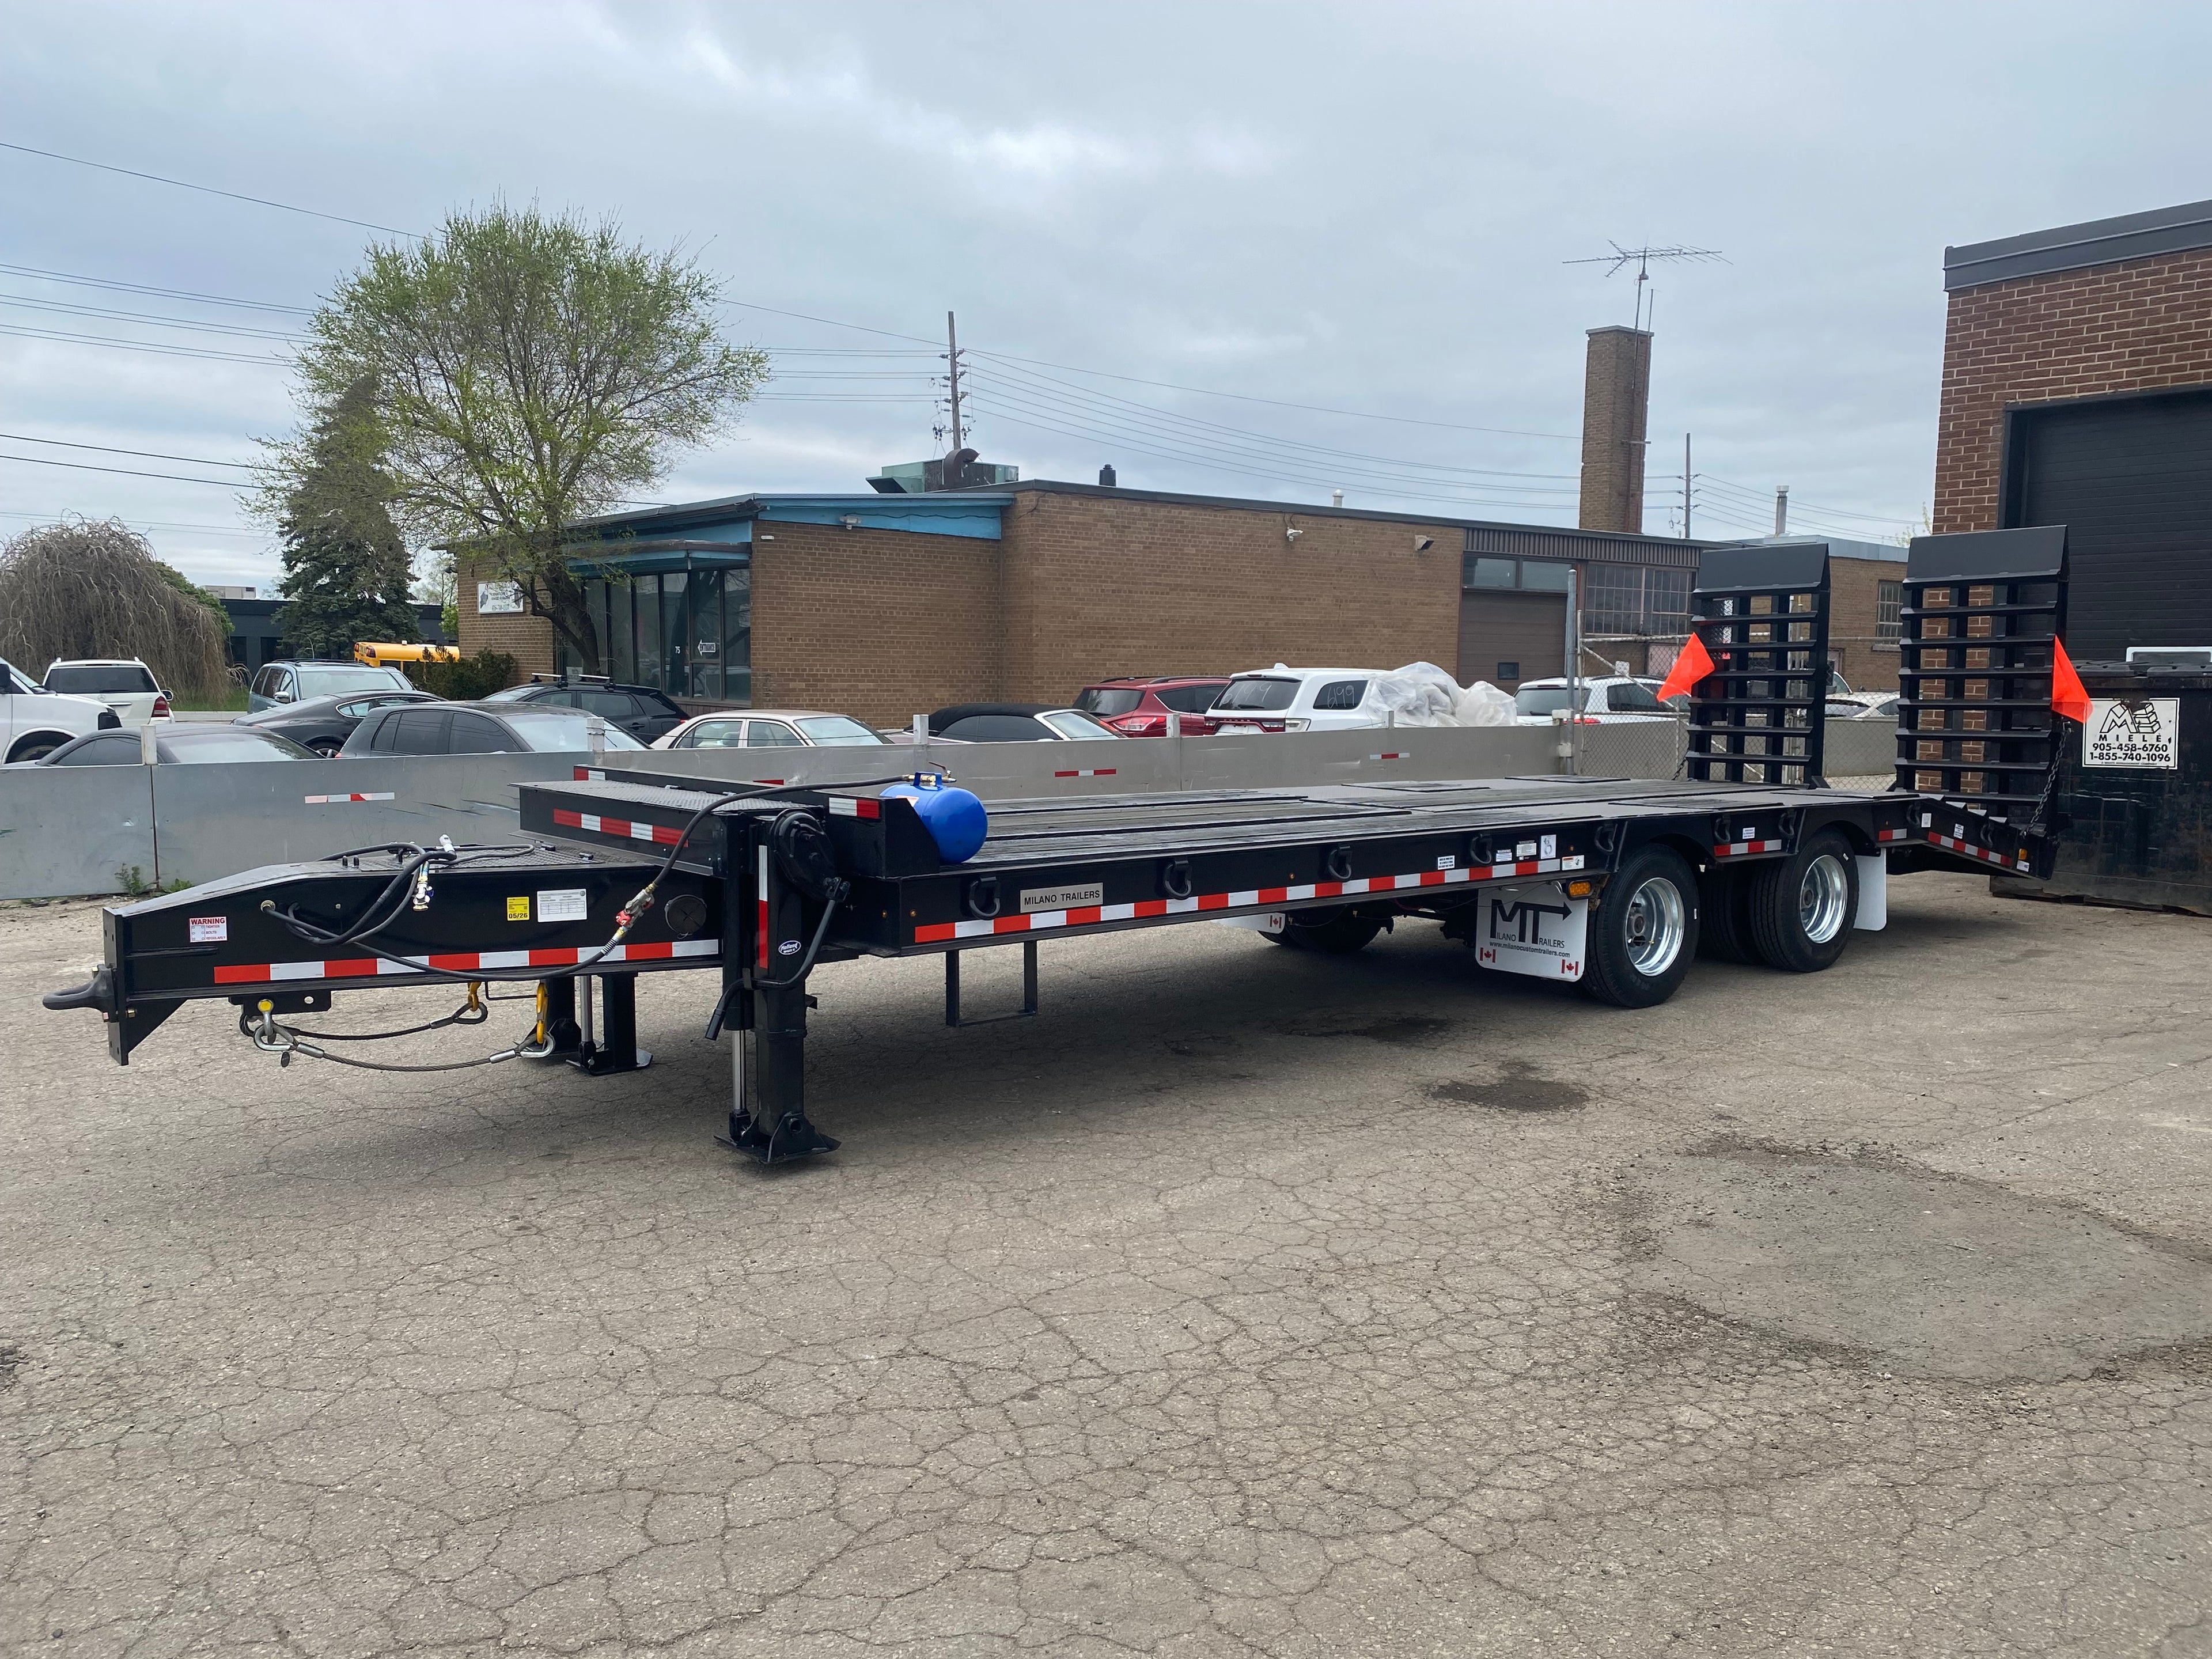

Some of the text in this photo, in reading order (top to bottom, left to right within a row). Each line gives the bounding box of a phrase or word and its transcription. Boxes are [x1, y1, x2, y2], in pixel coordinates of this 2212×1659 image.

[675, 646, 680, 654] 75
[699, 643, 715, 652] ENTRANCE
[1327, 685, 1354, 709] 6199
[2099, 734, 2161, 743] MIELE
[2093, 743, 2168, 752] 905-458-6760
[2090, 752, 2171, 762] 1-855-740-1096
[1024, 890, 1100, 905] MILANO TRAILERS
[1490, 941, 1570, 958] www.milanocustomtrailers.com
